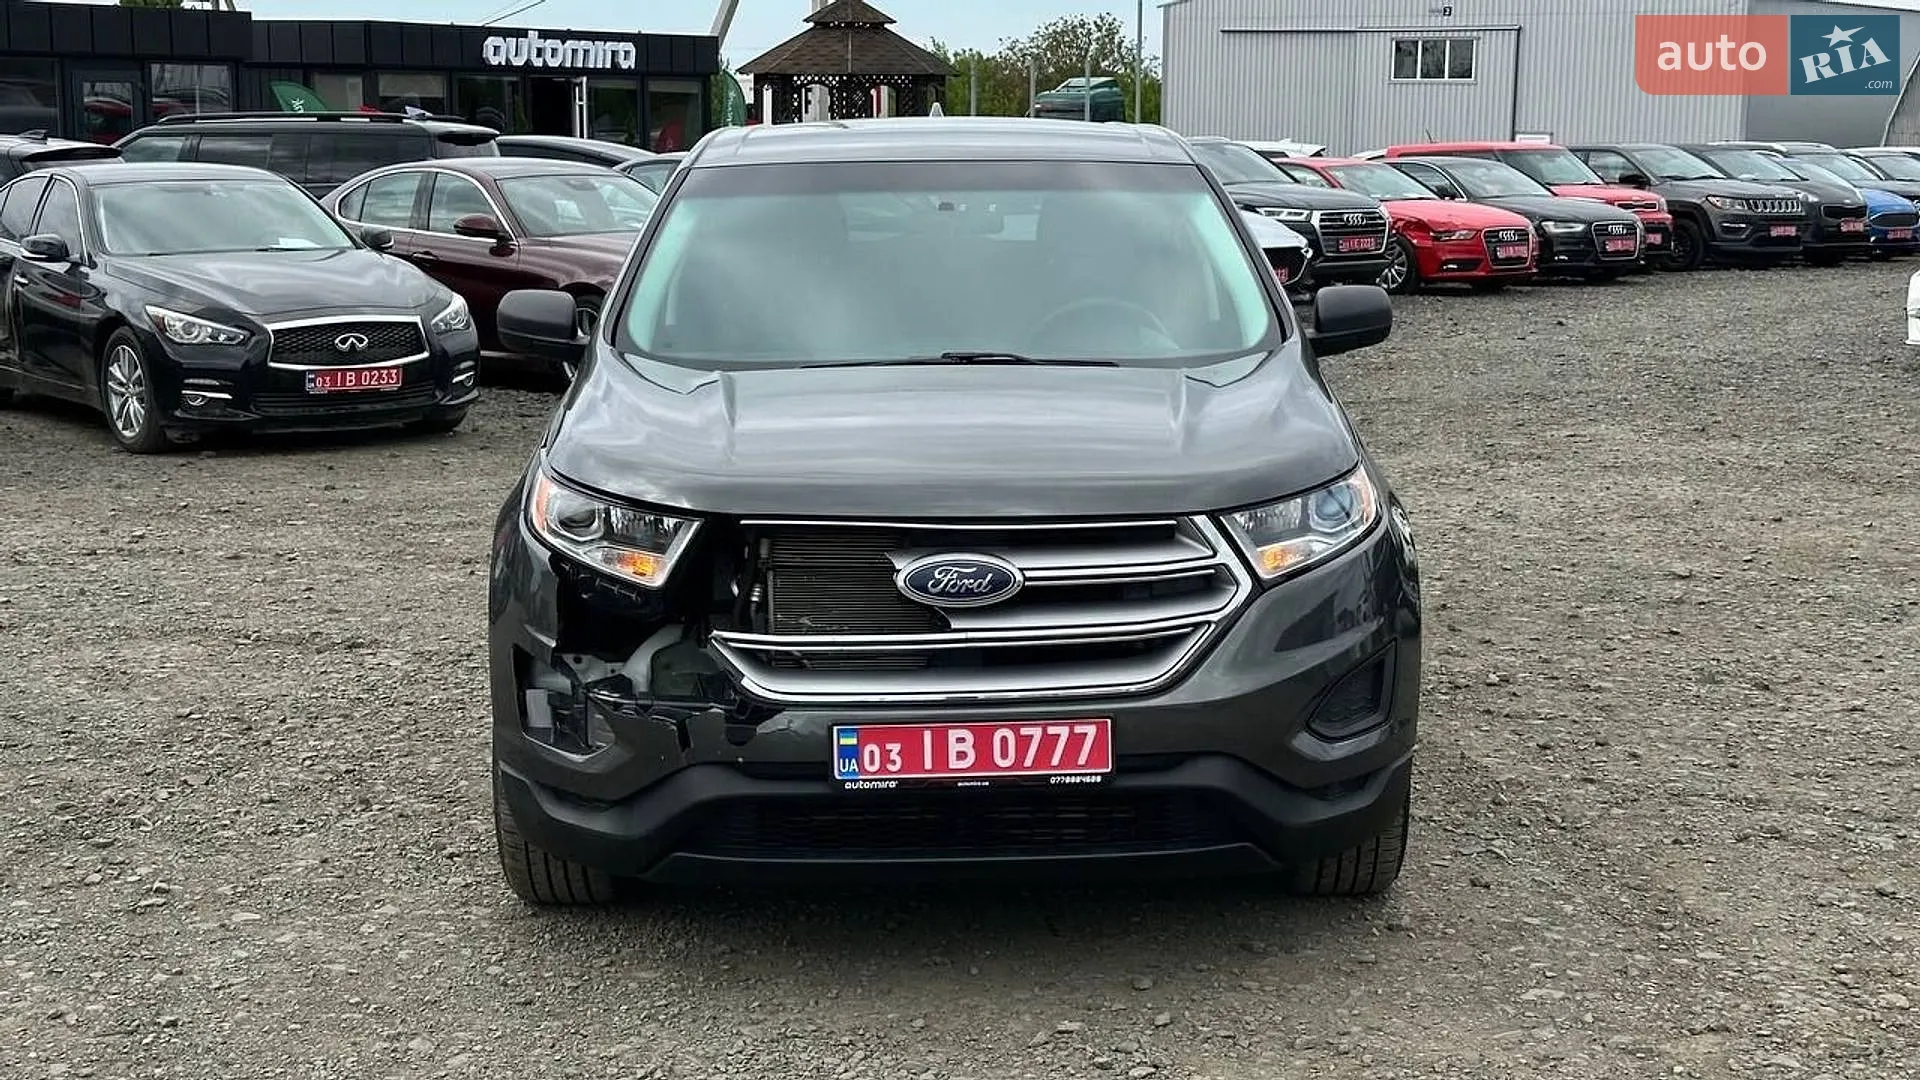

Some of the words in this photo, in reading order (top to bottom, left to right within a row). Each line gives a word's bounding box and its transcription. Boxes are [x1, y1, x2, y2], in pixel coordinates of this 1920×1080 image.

[483, 30, 636, 69] automira
[316, 376, 331, 387] 03
[361, 369, 398, 385] 0233
[927, 565, 994, 594] Ford
[863, 742, 903, 773] 03
[992, 724, 1098, 768] 0777
[839, 758, 859, 774] UA
[844, 780, 896, 790] automira
